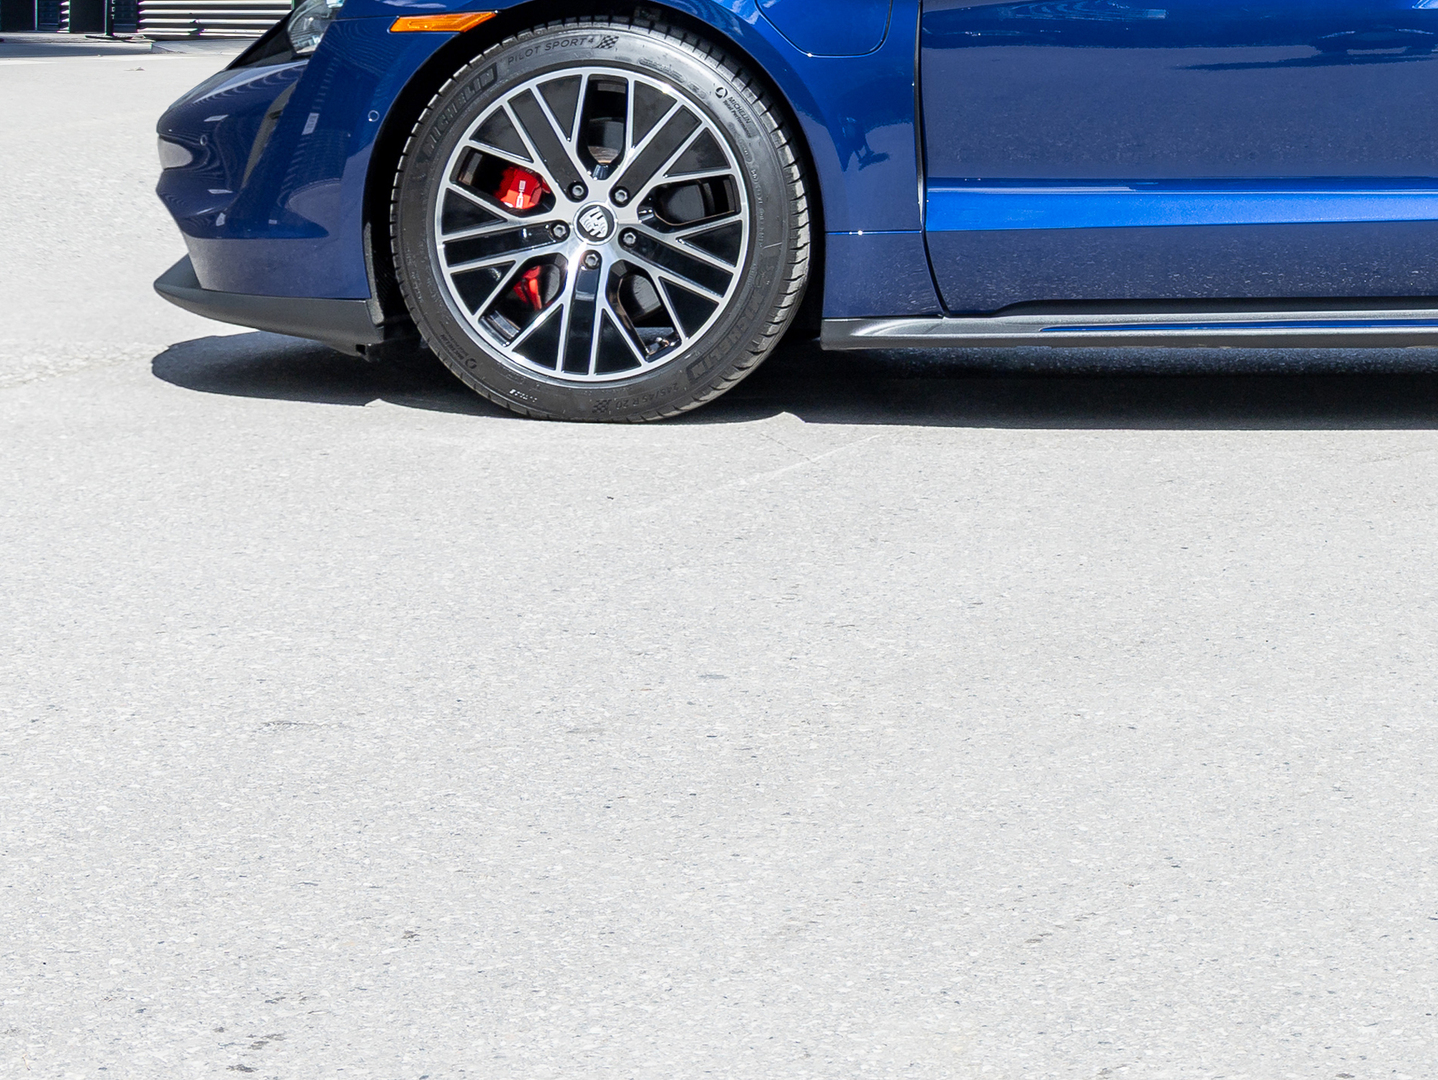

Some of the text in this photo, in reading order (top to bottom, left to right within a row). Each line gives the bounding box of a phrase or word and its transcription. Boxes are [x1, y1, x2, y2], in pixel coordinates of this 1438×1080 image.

[507, 46, 540, 66] PILOT
[422, 67, 495, 158] MICHELIN
[727, 96, 752, 125] MICHELIN
[689, 288, 765, 380] MICHELIN
